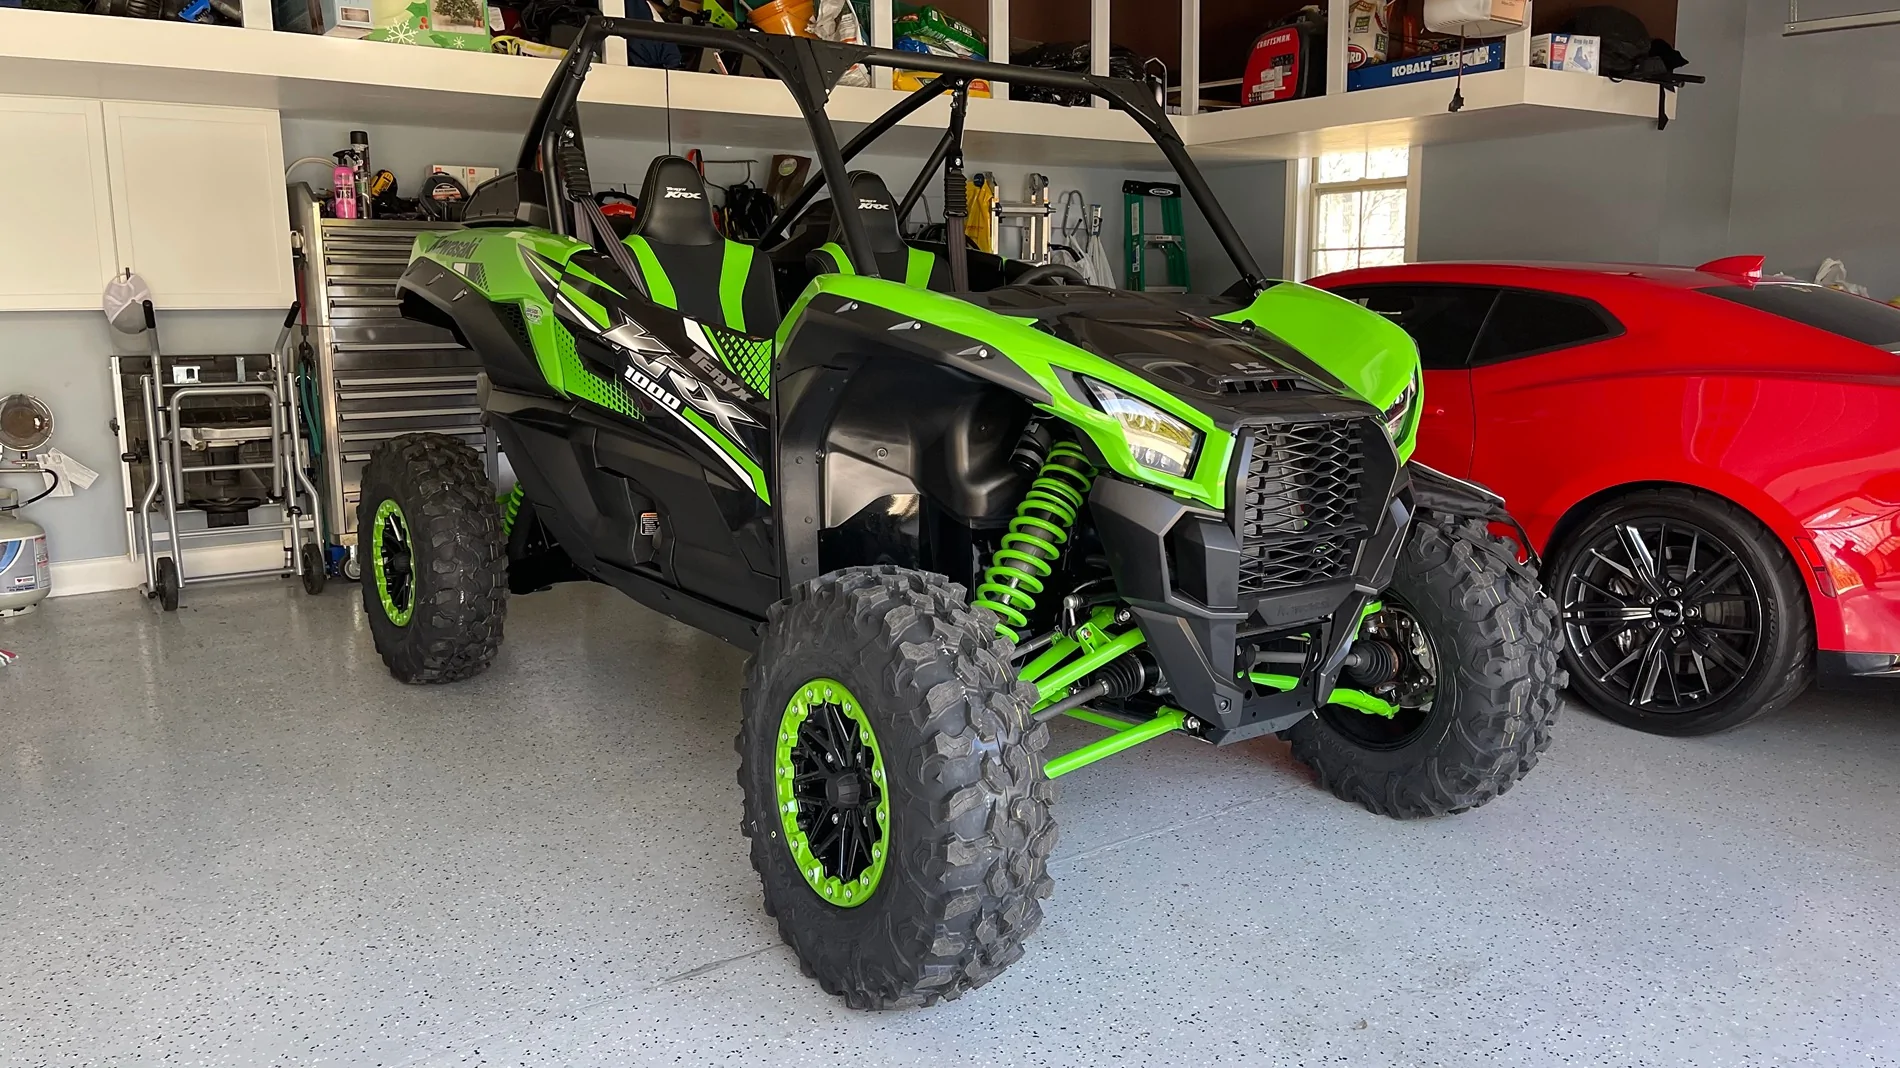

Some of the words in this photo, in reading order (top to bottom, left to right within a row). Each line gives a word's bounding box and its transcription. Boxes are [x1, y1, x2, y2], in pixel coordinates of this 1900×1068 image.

[1256, 33, 1291, 49] CRAFTSMAN
[1348, 51, 1362, 63] RD
[1392, 60, 1431, 77] KOBALT
[664, 190, 702, 200] KRX
[857, 202, 890, 211] KRX
[425, 235, 483, 260] Kawasaki
[600, 311, 763, 455] KRX
[624, 364, 682, 411] 1000
